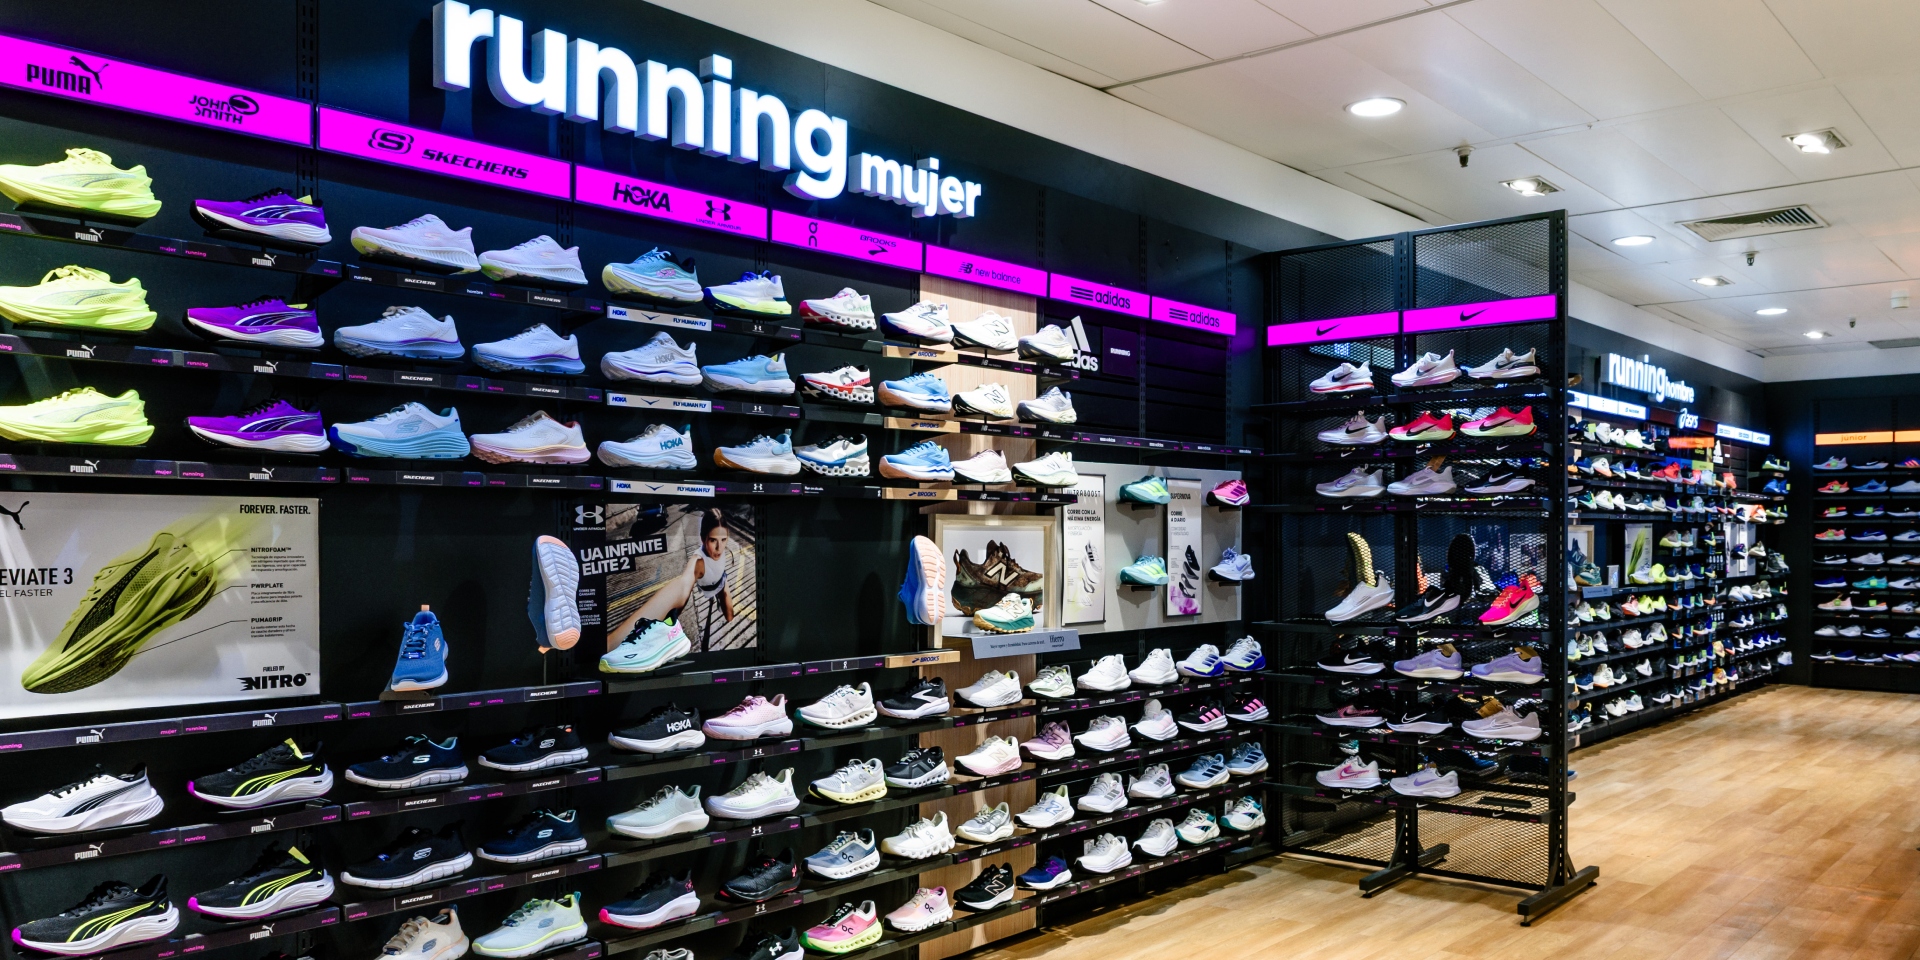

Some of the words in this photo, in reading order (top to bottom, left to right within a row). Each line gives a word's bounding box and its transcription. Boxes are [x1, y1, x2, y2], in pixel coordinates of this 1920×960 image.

[27, 64, 91, 95] PUMA
[189, 95, 231, 112] JOHN
[434, 0, 848, 200] running
[850, 153, 982, 219] mujer
[421, 148, 529, 180] SKECHERS
[612, 182, 671, 212] HOKA
[75, 232, 98, 242] PUMA
[859, 234, 897, 248] BROOKS
[252, 256, 272, 267] PUMA
[974, 266, 990, 278] new
[991, 269, 1021, 285] balance
[1095, 291, 1131, 310] adidas
[612, 309, 627, 317] HOKA
[1189, 311, 1220, 328] adidas
[67, 348, 90, 358] PUMA
[1110, 347, 1131, 357] RUNNING
[655, 353, 676, 365] HOKA
[254, 365, 273, 373] PUMA
[1606, 353, 1666, 403] running
[1665, 376, 1695, 404] hombre
[1840, 432, 1867, 443] júnior
[660, 437, 684, 451] HOKA
[70, 463, 94, 473] PUMA
[250, 472, 269, 480] PUMA
[240, 504, 279, 514] FOREVER.
[280, 505, 311, 515] FASTER.
[581, 547, 603, 562] UA
[604, 538, 663, 557] INFINITE
[582, 560, 619, 576] ELITE
[620, 557, 631, 570] 2
[0, 567, 58, 586] EVIATE
[63, 567, 74, 585] 3
[16, 588, 53, 598] FASTER
[253, 719, 272, 727] PUMA
[667, 718, 692, 733] HOKA
[76, 735, 99, 744] PUMA
[405, 798, 436, 806] SKECHERS
[251, 824, 271, 833] PUMA
[75, 851, 98, 860] PUMA
[532, 870, 559, 878] SKECHERS
[401, 895, 432, 904] SKECHERS
[250, 931, 270, 940] PUMA
